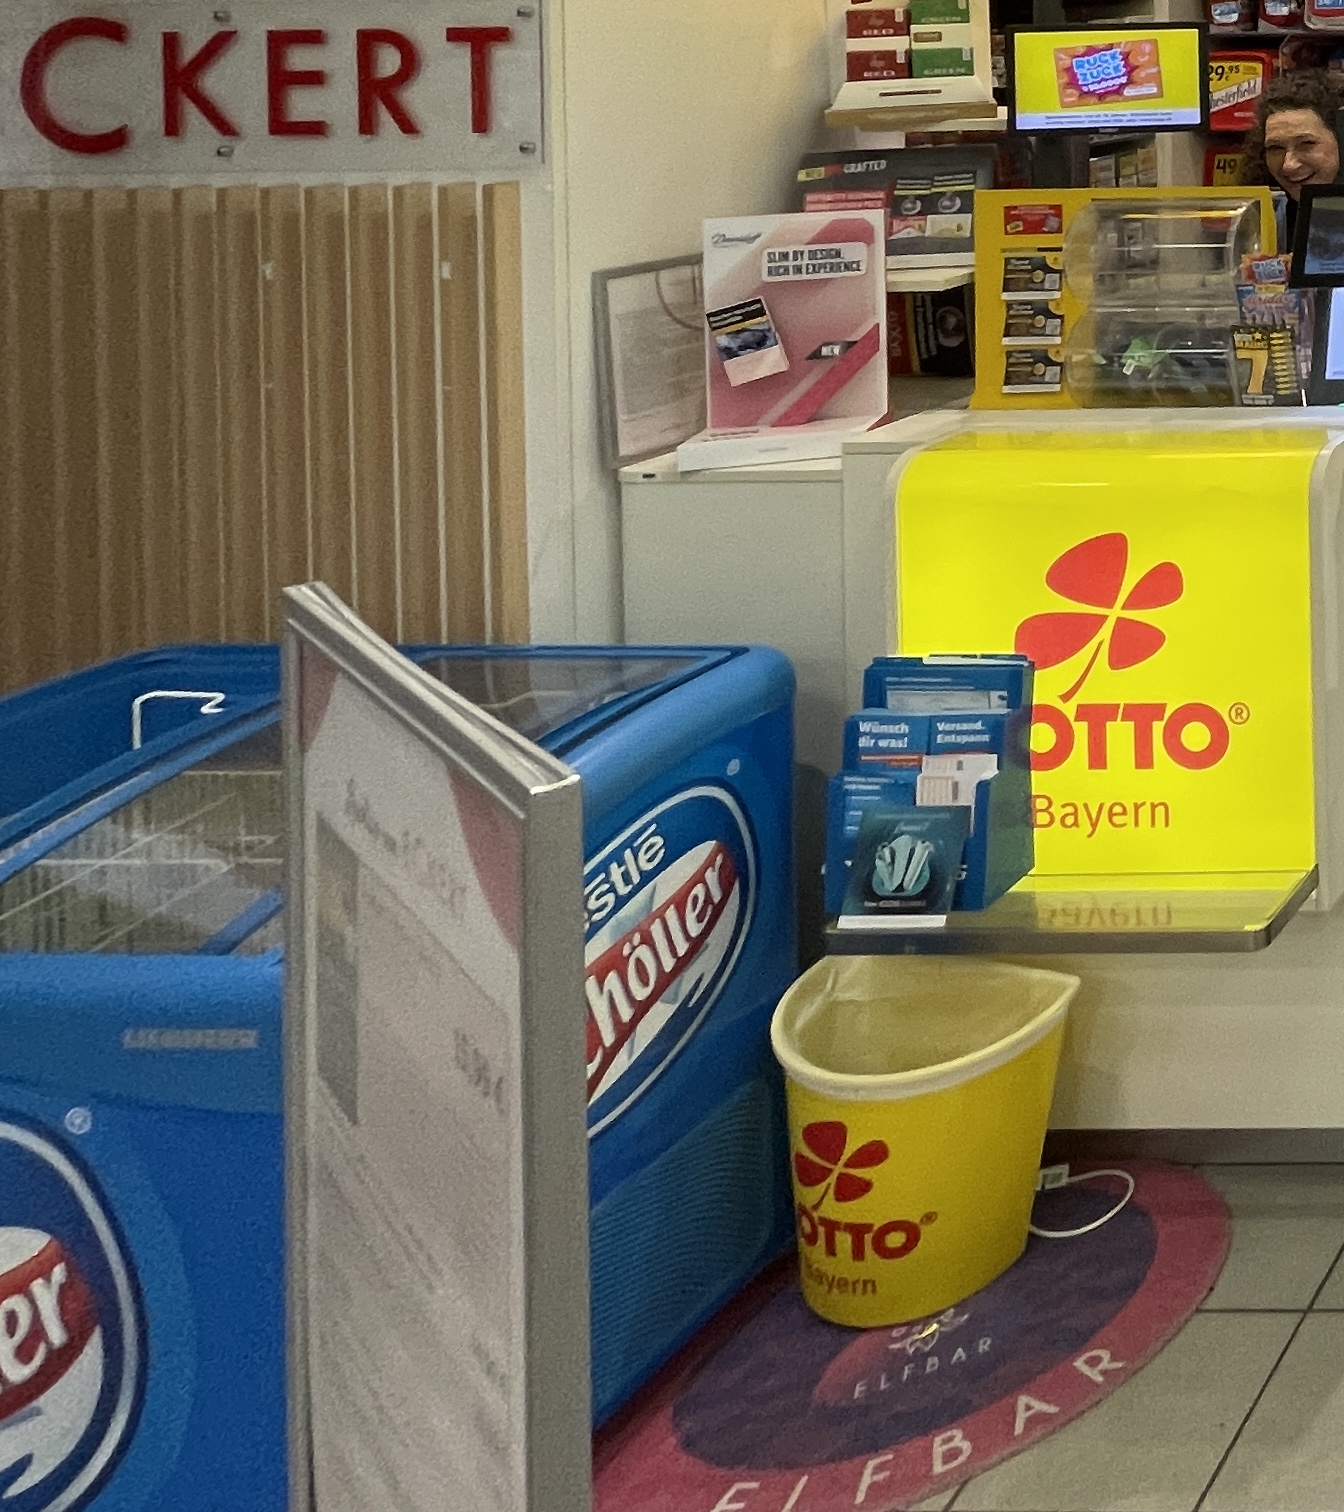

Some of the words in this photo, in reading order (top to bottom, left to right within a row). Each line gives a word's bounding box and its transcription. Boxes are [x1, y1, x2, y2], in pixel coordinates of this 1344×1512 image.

[1073, 50, 1122, 70] RUCK
[1079, 64, 1124, 82] ZUCK
[843, 160, 887, 173] CRAFTED
[1216, 159, 1238, 174] 49
[767, 251, 790, 263] SLIM
[792, 250, 805, 261] BY
[767, 265, 790, 277] RICH
[792, 264, 803, 275] IN
[805, 261, 862, 274] EXPERIENCE
[1236, 349, 1268, 394] 7
[859, 721, 909, 733] Wünsch
[1018, 702, 1229, 770] OTTO
[859, 738, 875, 747] dir
[1032, 796, 1170, 837] Bayern
[584, 824, 667, 931] stlé
[587, 856, 733, 1075] höller
[798, 1203, 921, 1261] OTTO
